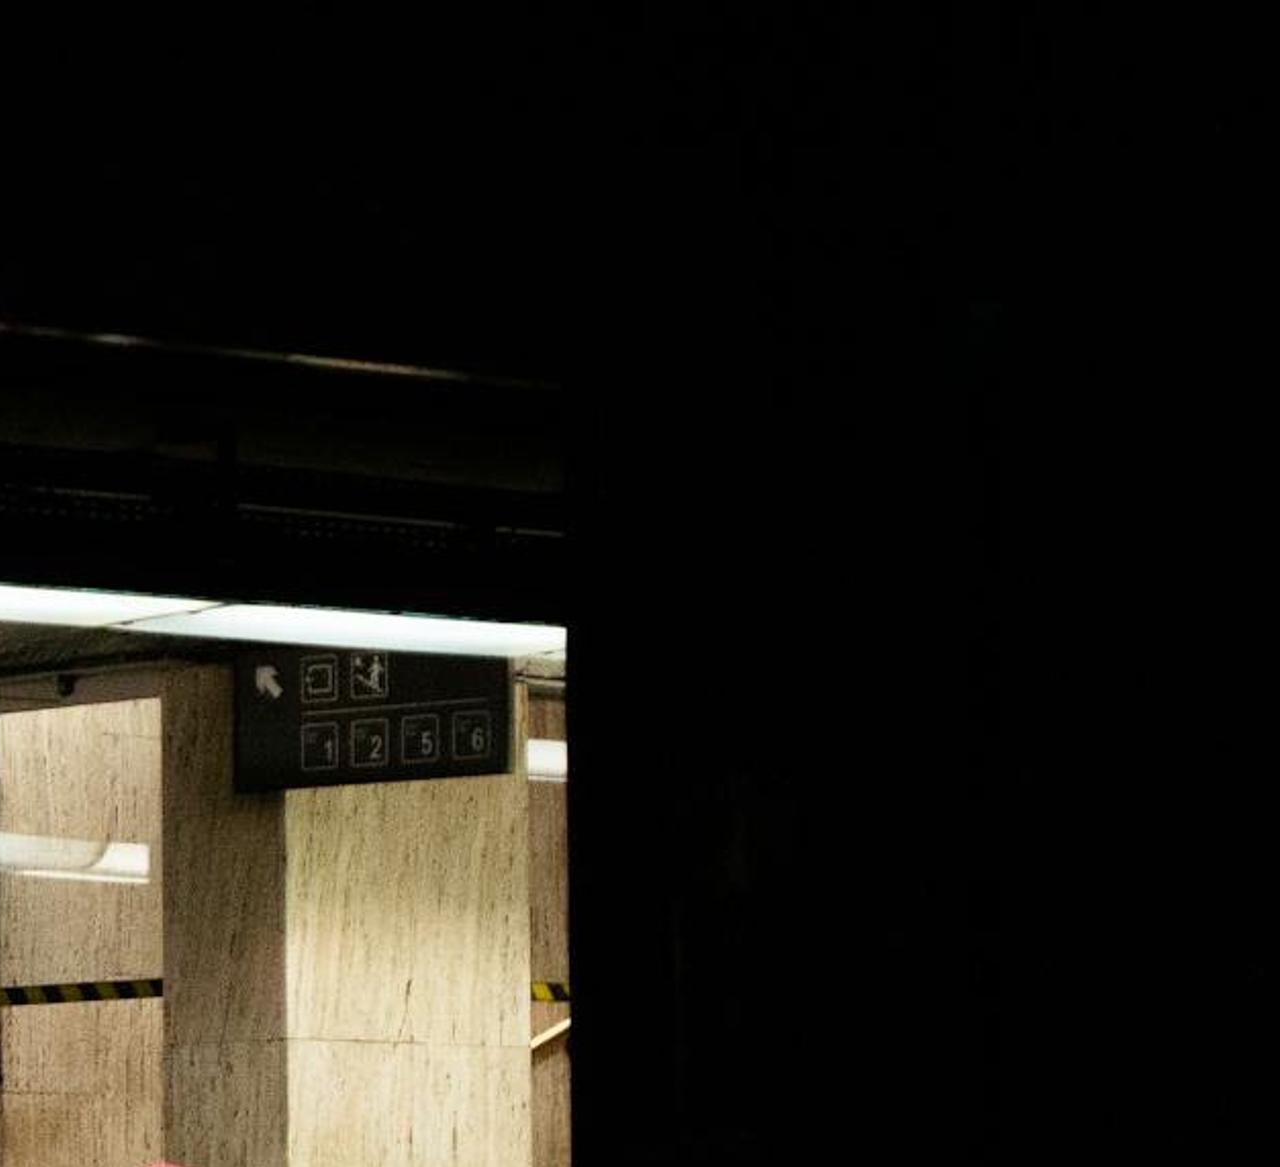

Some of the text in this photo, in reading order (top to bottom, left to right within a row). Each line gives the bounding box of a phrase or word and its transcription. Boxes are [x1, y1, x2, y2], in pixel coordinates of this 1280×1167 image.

[323, 726, 485, 762] 1 2 5 6
